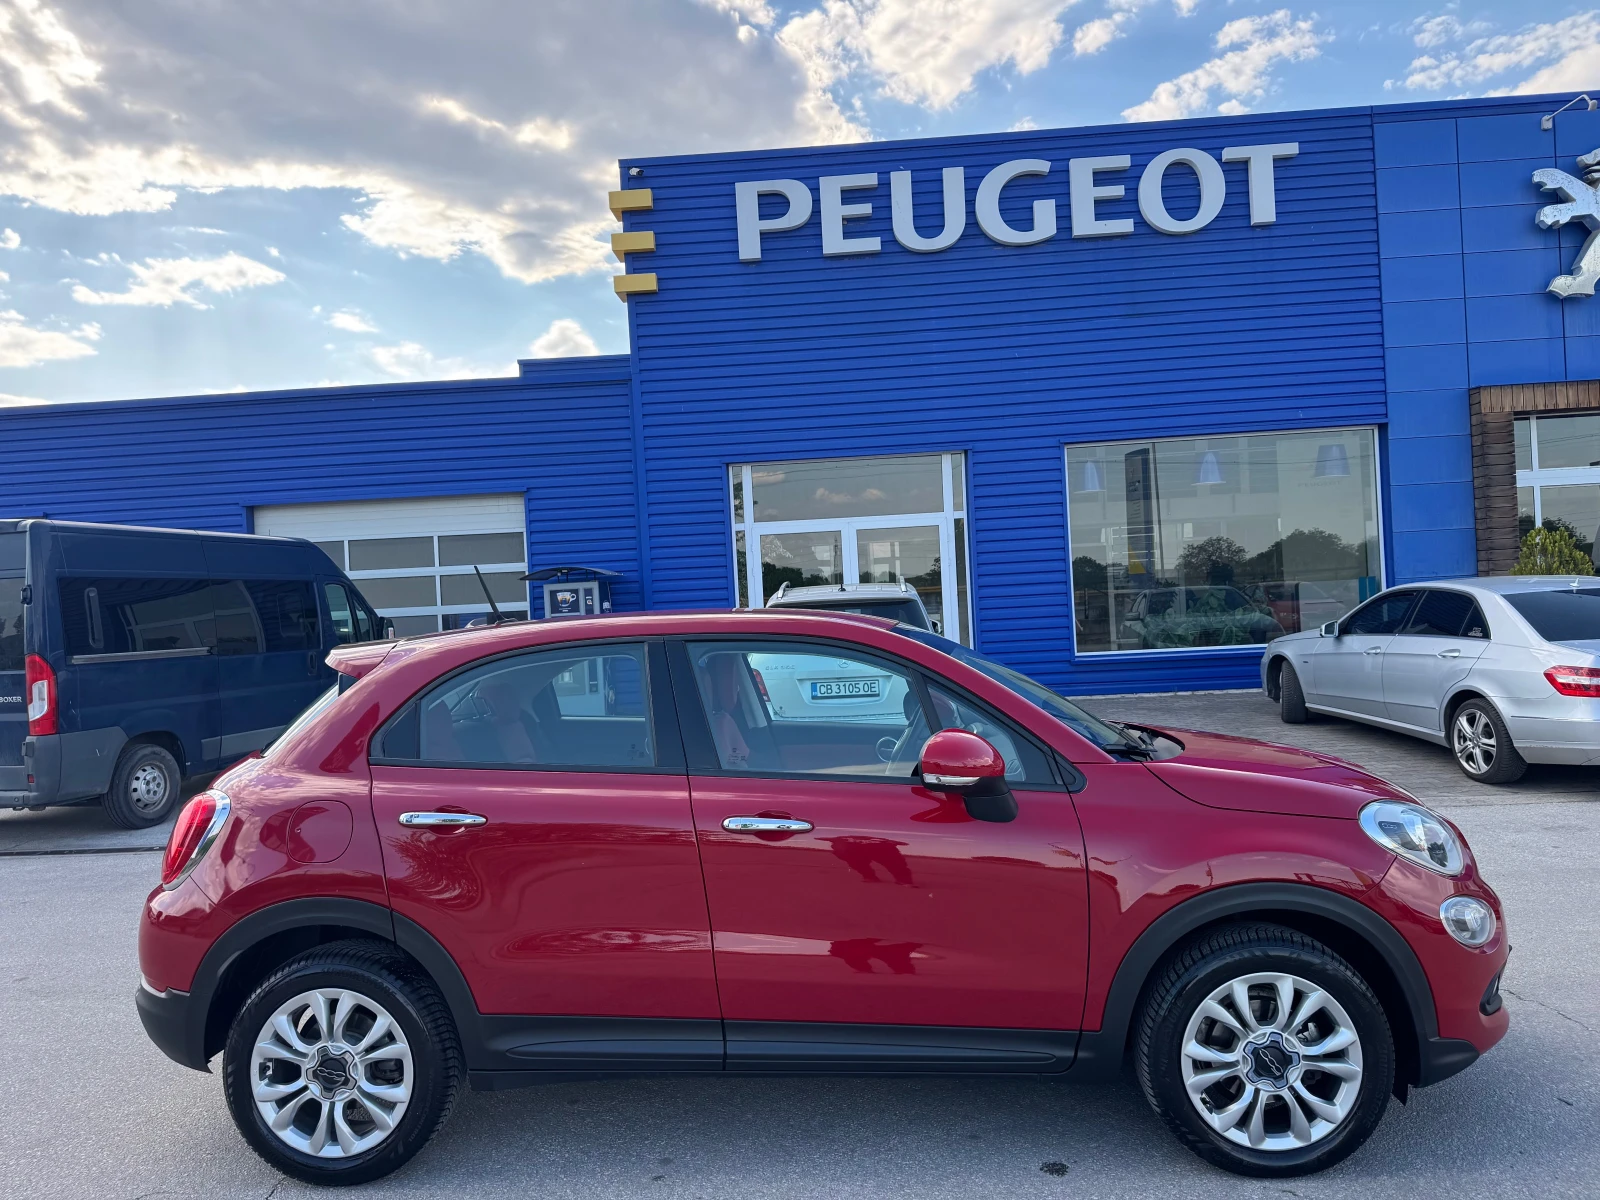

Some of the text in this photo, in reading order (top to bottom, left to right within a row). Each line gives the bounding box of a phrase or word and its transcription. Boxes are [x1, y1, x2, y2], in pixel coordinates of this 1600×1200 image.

[735, 142, 1300, 262] PEUGEOT
[819, 684, 833, 695] CB
[835, 682, 861, 695] 3105
[862, 682, 877, 693] OE
